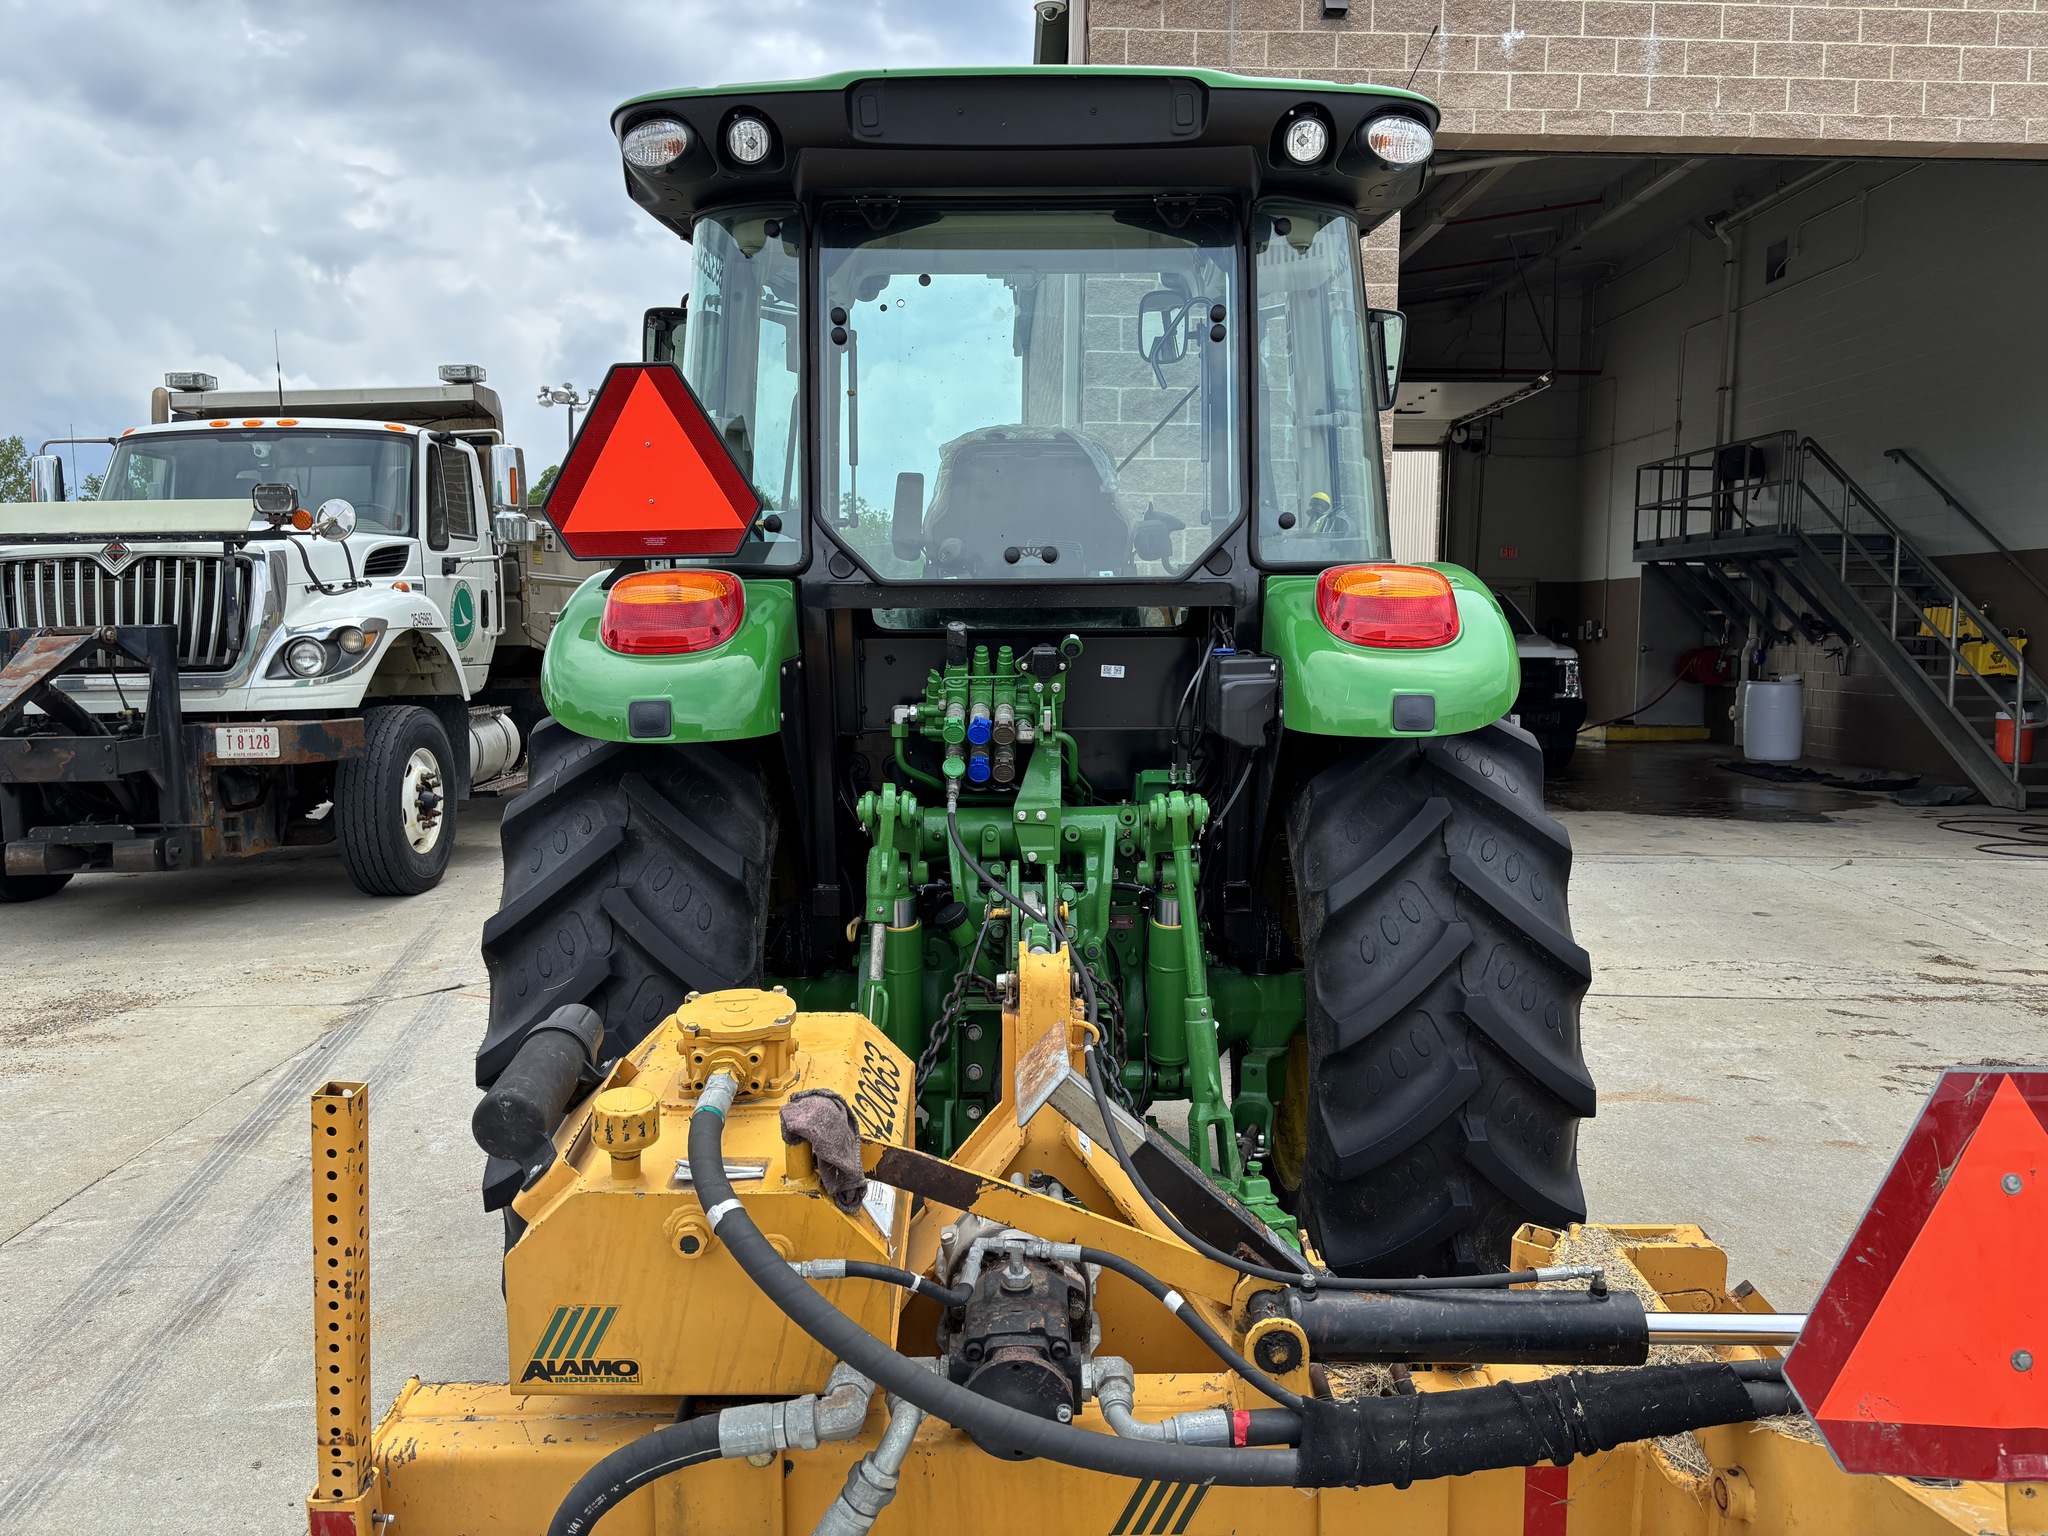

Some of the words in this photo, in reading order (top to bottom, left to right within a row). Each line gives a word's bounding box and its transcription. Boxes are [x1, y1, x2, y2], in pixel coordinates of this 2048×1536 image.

[226, 735, 232, 750] T
[237, 735, 244, 750] 8
[248, 735, 270, 750] 128
[852, 1040, 900, 1141] 420663
[520, 1360, 639, 1383] ALAMO
